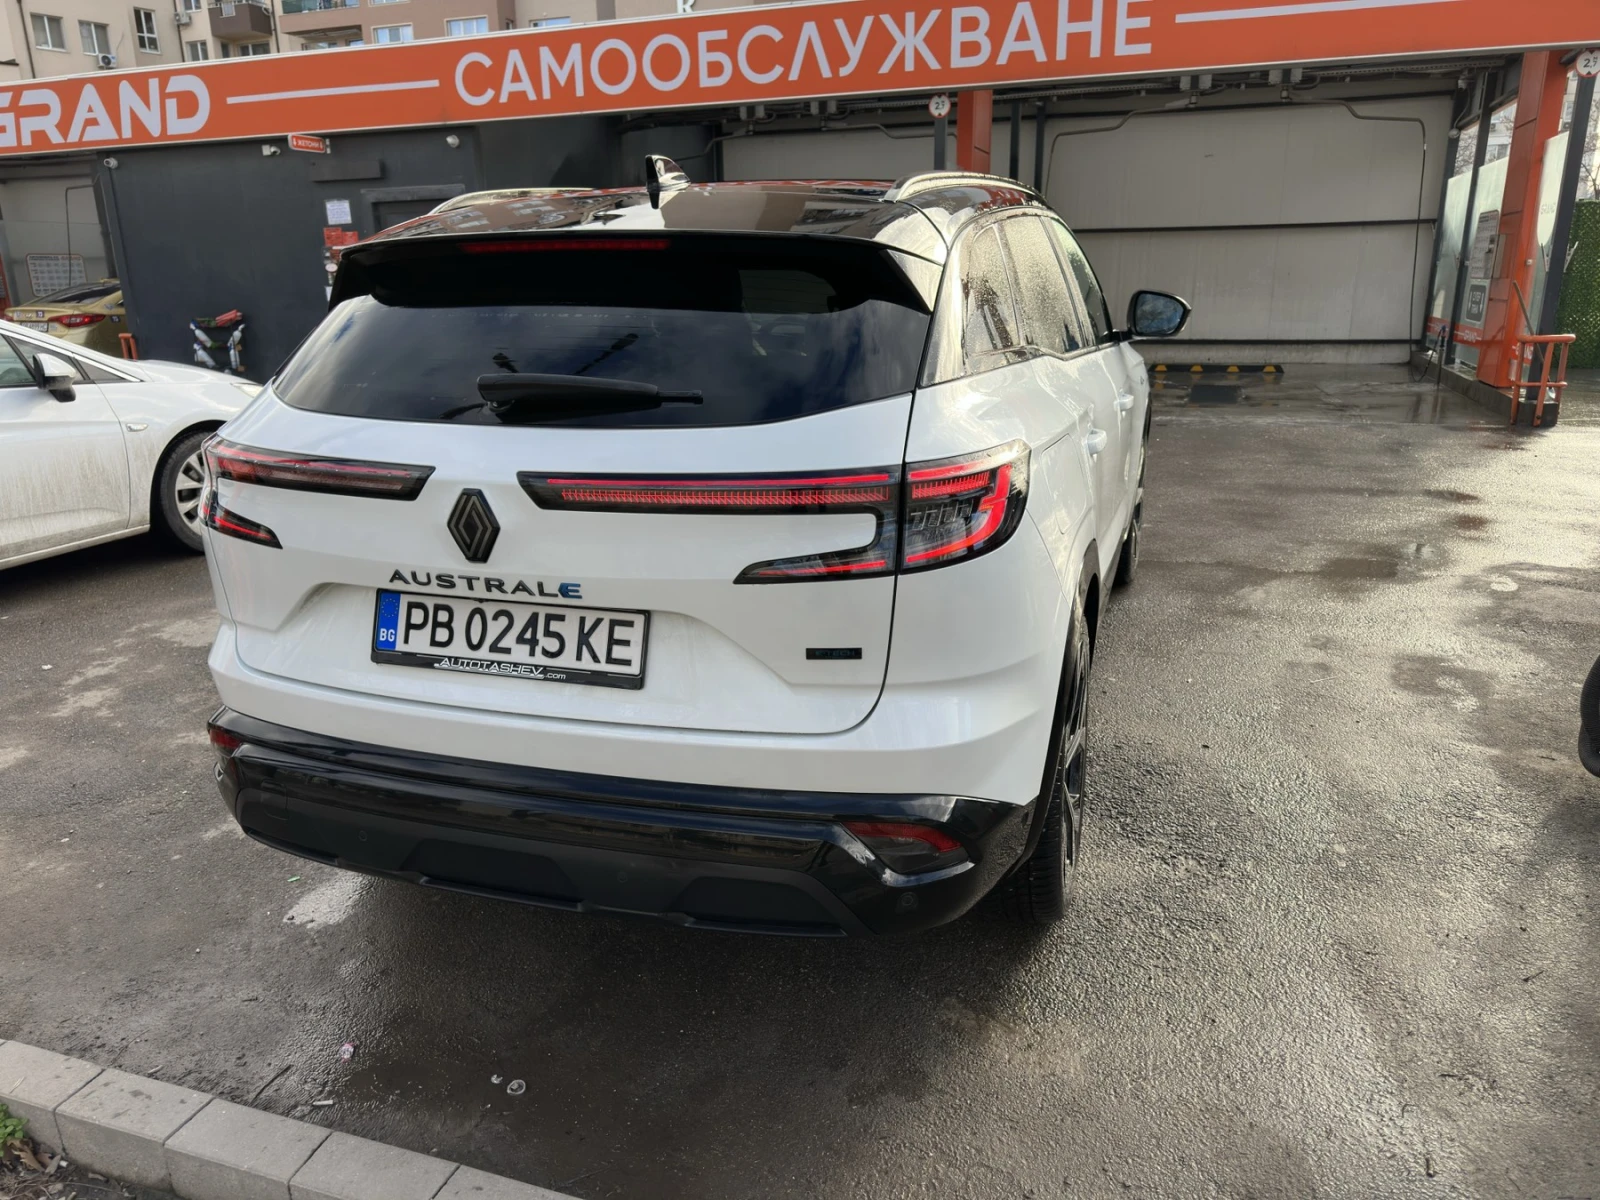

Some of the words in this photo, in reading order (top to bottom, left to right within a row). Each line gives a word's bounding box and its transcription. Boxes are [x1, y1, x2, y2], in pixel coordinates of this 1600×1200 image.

[455, 0, 1152, 106] САМООБСЛУЖВАНЕ
[389, 569, 582, 599] AUSTRALE
[379, 628, 395, 642] BG
[403, 601, 454, 648] PB
[465, 607, 566, 659] 0245
[575, 616, 635, 667] KE
